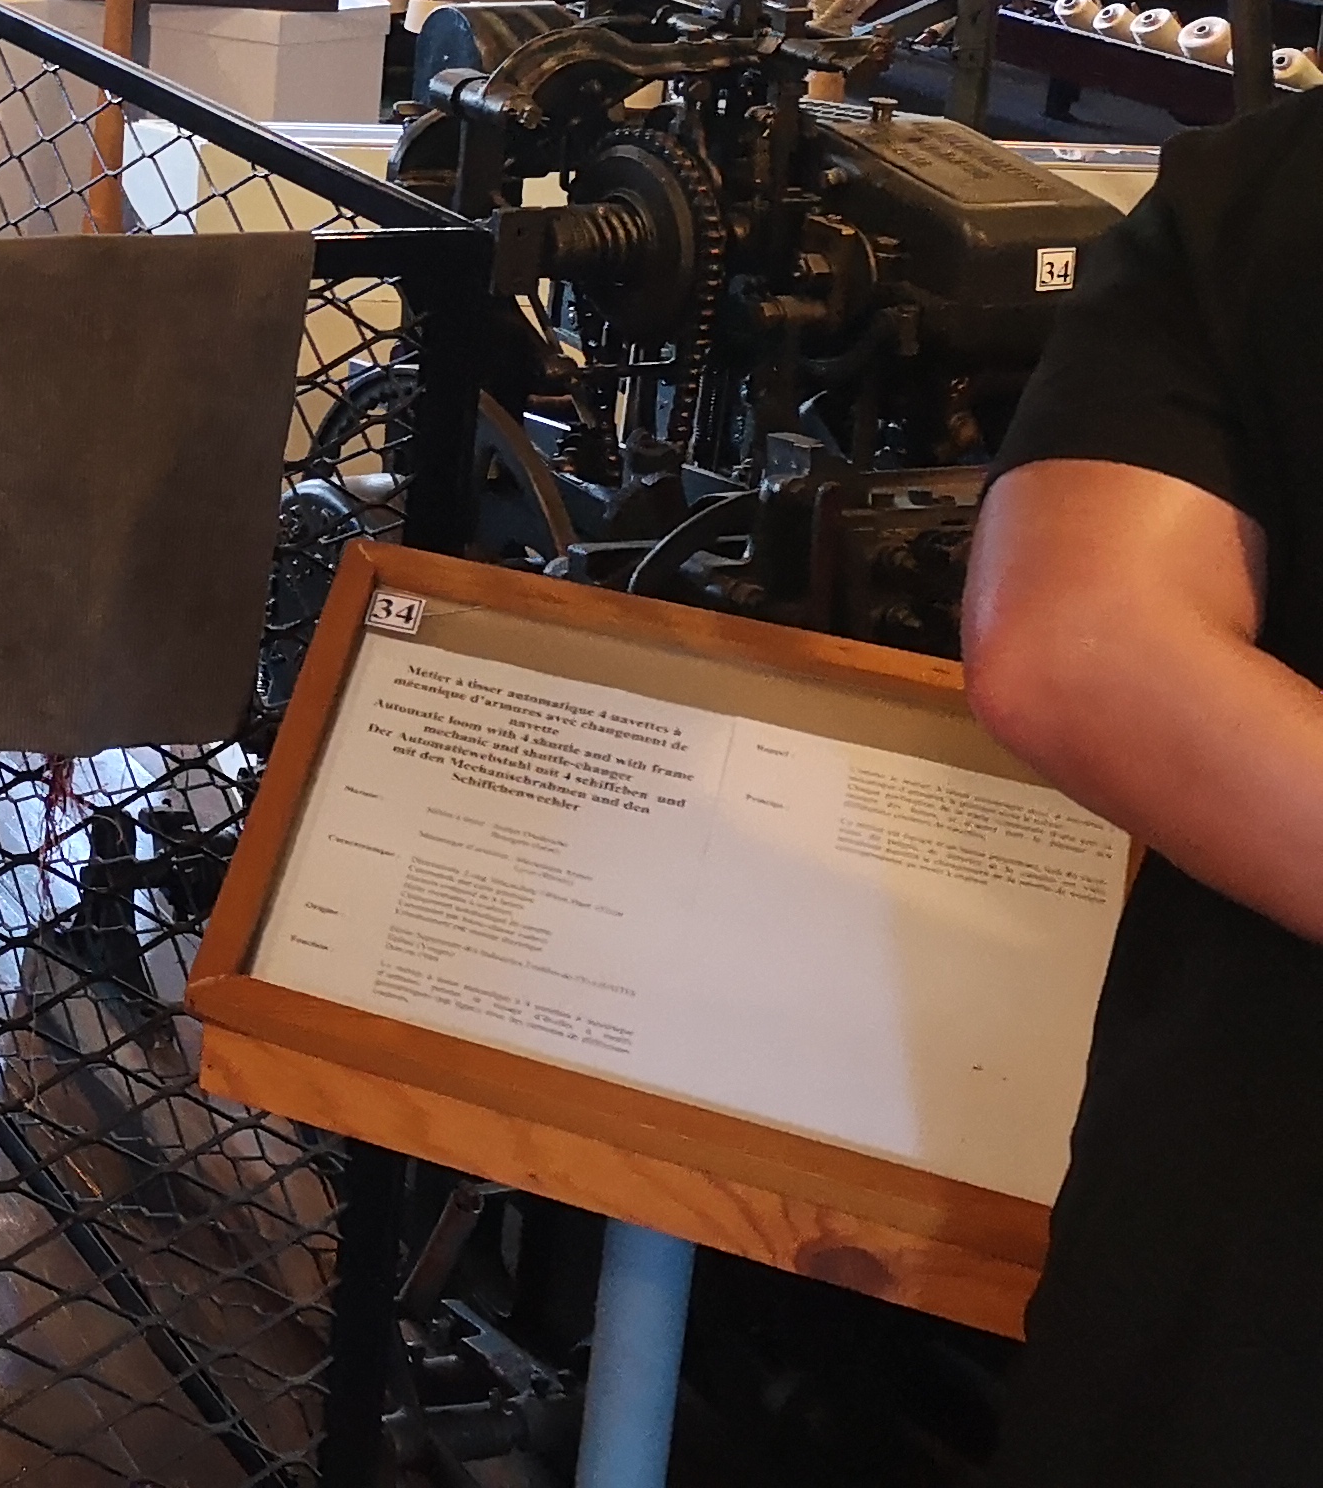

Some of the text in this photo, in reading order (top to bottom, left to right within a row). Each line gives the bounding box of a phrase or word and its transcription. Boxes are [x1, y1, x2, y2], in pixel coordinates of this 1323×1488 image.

[1041, 260, 1070, 284] 34
[371, 598, 417, 624] 34
[455, 677, 463, 687] à
[468, 678, 503, 695] tisser
[507, 690, 595, 717] automatique
[610, 714, 669, 734] navettes
[673, 727, 682, 737] à
[509, 718, 560, 736] navette
[545, 713, 577, 727] avec
[580, 720, 667, 748] changement
[671, 741, 689, 752] de
[368, 723, 393, 737] Der
[535, 767, 560, 778] mit
[563, 772, 572, 781] 4
[657, 795, 687, 808] und
[374, 698, 445, 723] Automatic
[448, 715, 482, 731] loom
[487, 727, 516, 740] with
[521, 733, 529, 742] 4
[584, 750, 611, 762] and
[615, 756, 647, 772] with
[651, 764, 695, 781] frame
[423, 725, 488, 747] mechanic
[522, 748, 634, 782] shuttle-changer
[393, 745, 417, 757] mit
[420, 751, 445, 764] den
[623, 801, 650, 814] den
